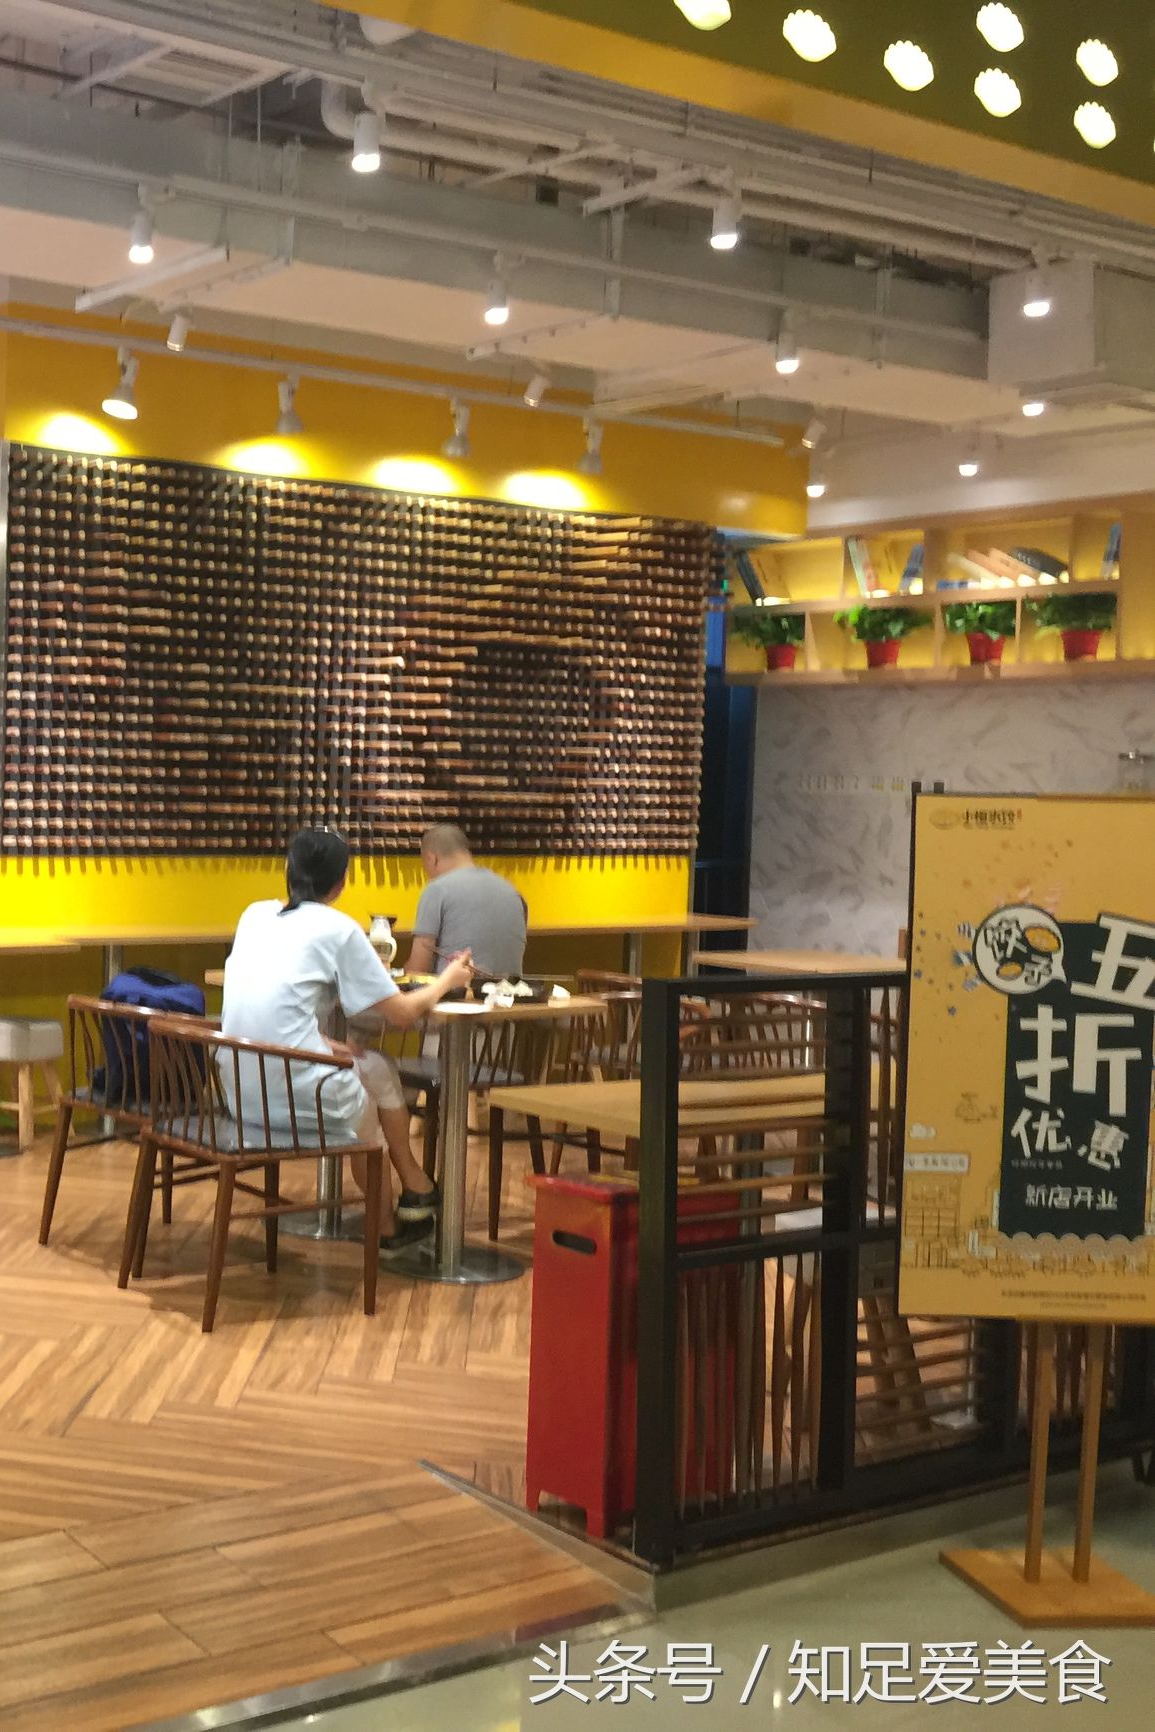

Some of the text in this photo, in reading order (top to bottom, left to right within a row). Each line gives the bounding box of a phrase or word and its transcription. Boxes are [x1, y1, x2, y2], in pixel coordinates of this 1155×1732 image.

[1011, 1107, 1130, 1172] 优惠
[1025, 1183, 1119, 1210] 新店开业
